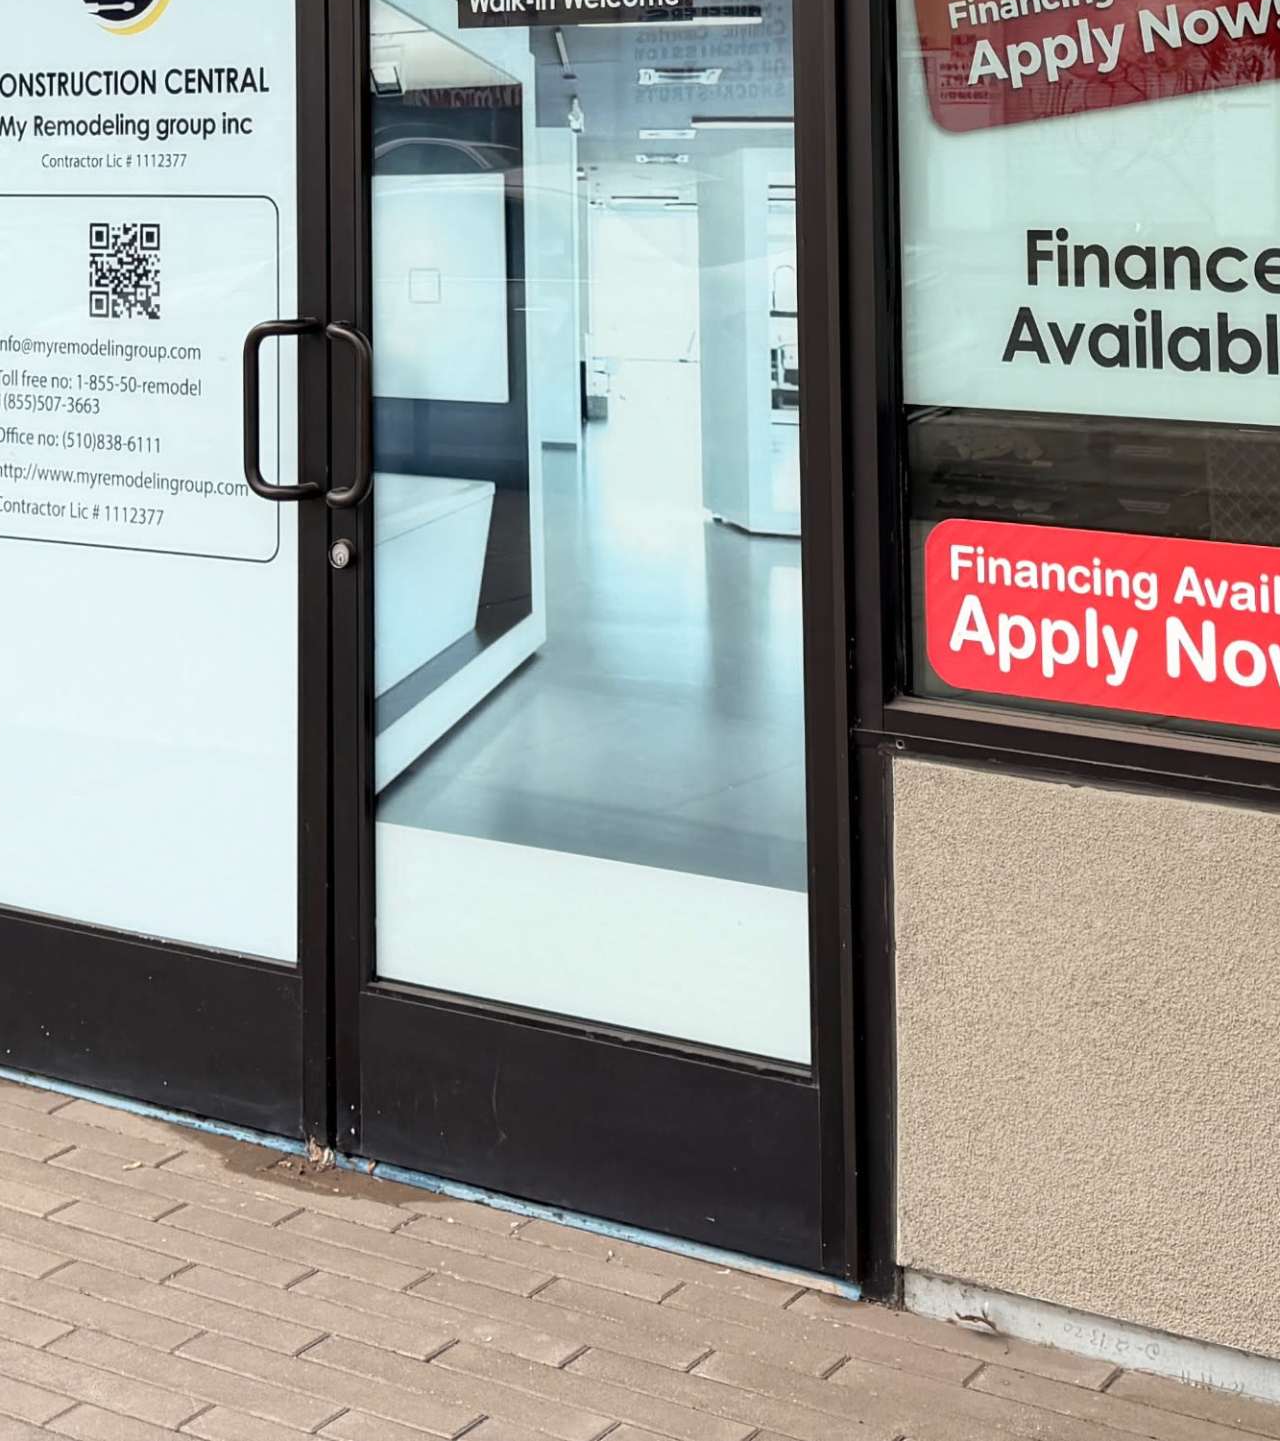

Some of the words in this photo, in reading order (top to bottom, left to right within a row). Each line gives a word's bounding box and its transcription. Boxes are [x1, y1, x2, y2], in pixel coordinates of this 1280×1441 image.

[968, 17, 1124, 88] Apply
[165, 67, 269, 94] CENTRAL
[0, 116, 27, 141] My
[34, 114, 149, 140] Remodeling
[157, 118, 215, 140] group
[223, 112, 252, 134] inc
[42, 154, 103, 168] Contractor
[107, 154, 122, 167] Lic
[125, 155, 134, 167] #
[137, 154, 187, 167] 1112377
[22, 370, 47, 388] free
[52, 377, 71, 389] no:
[78, 375, 201, 396] 1-855-50-remodel
[38, 434, 58, 446] no:
[63, 432, 159, 452] (510)838-6111
[71, 502, 88, 519] Lic
[92, 504, 99, 519] #
[106, 506, 164, 525] 1112377
[951, 545, 1157, 611] Financing
[950, 593, 1139, 686] Apply
